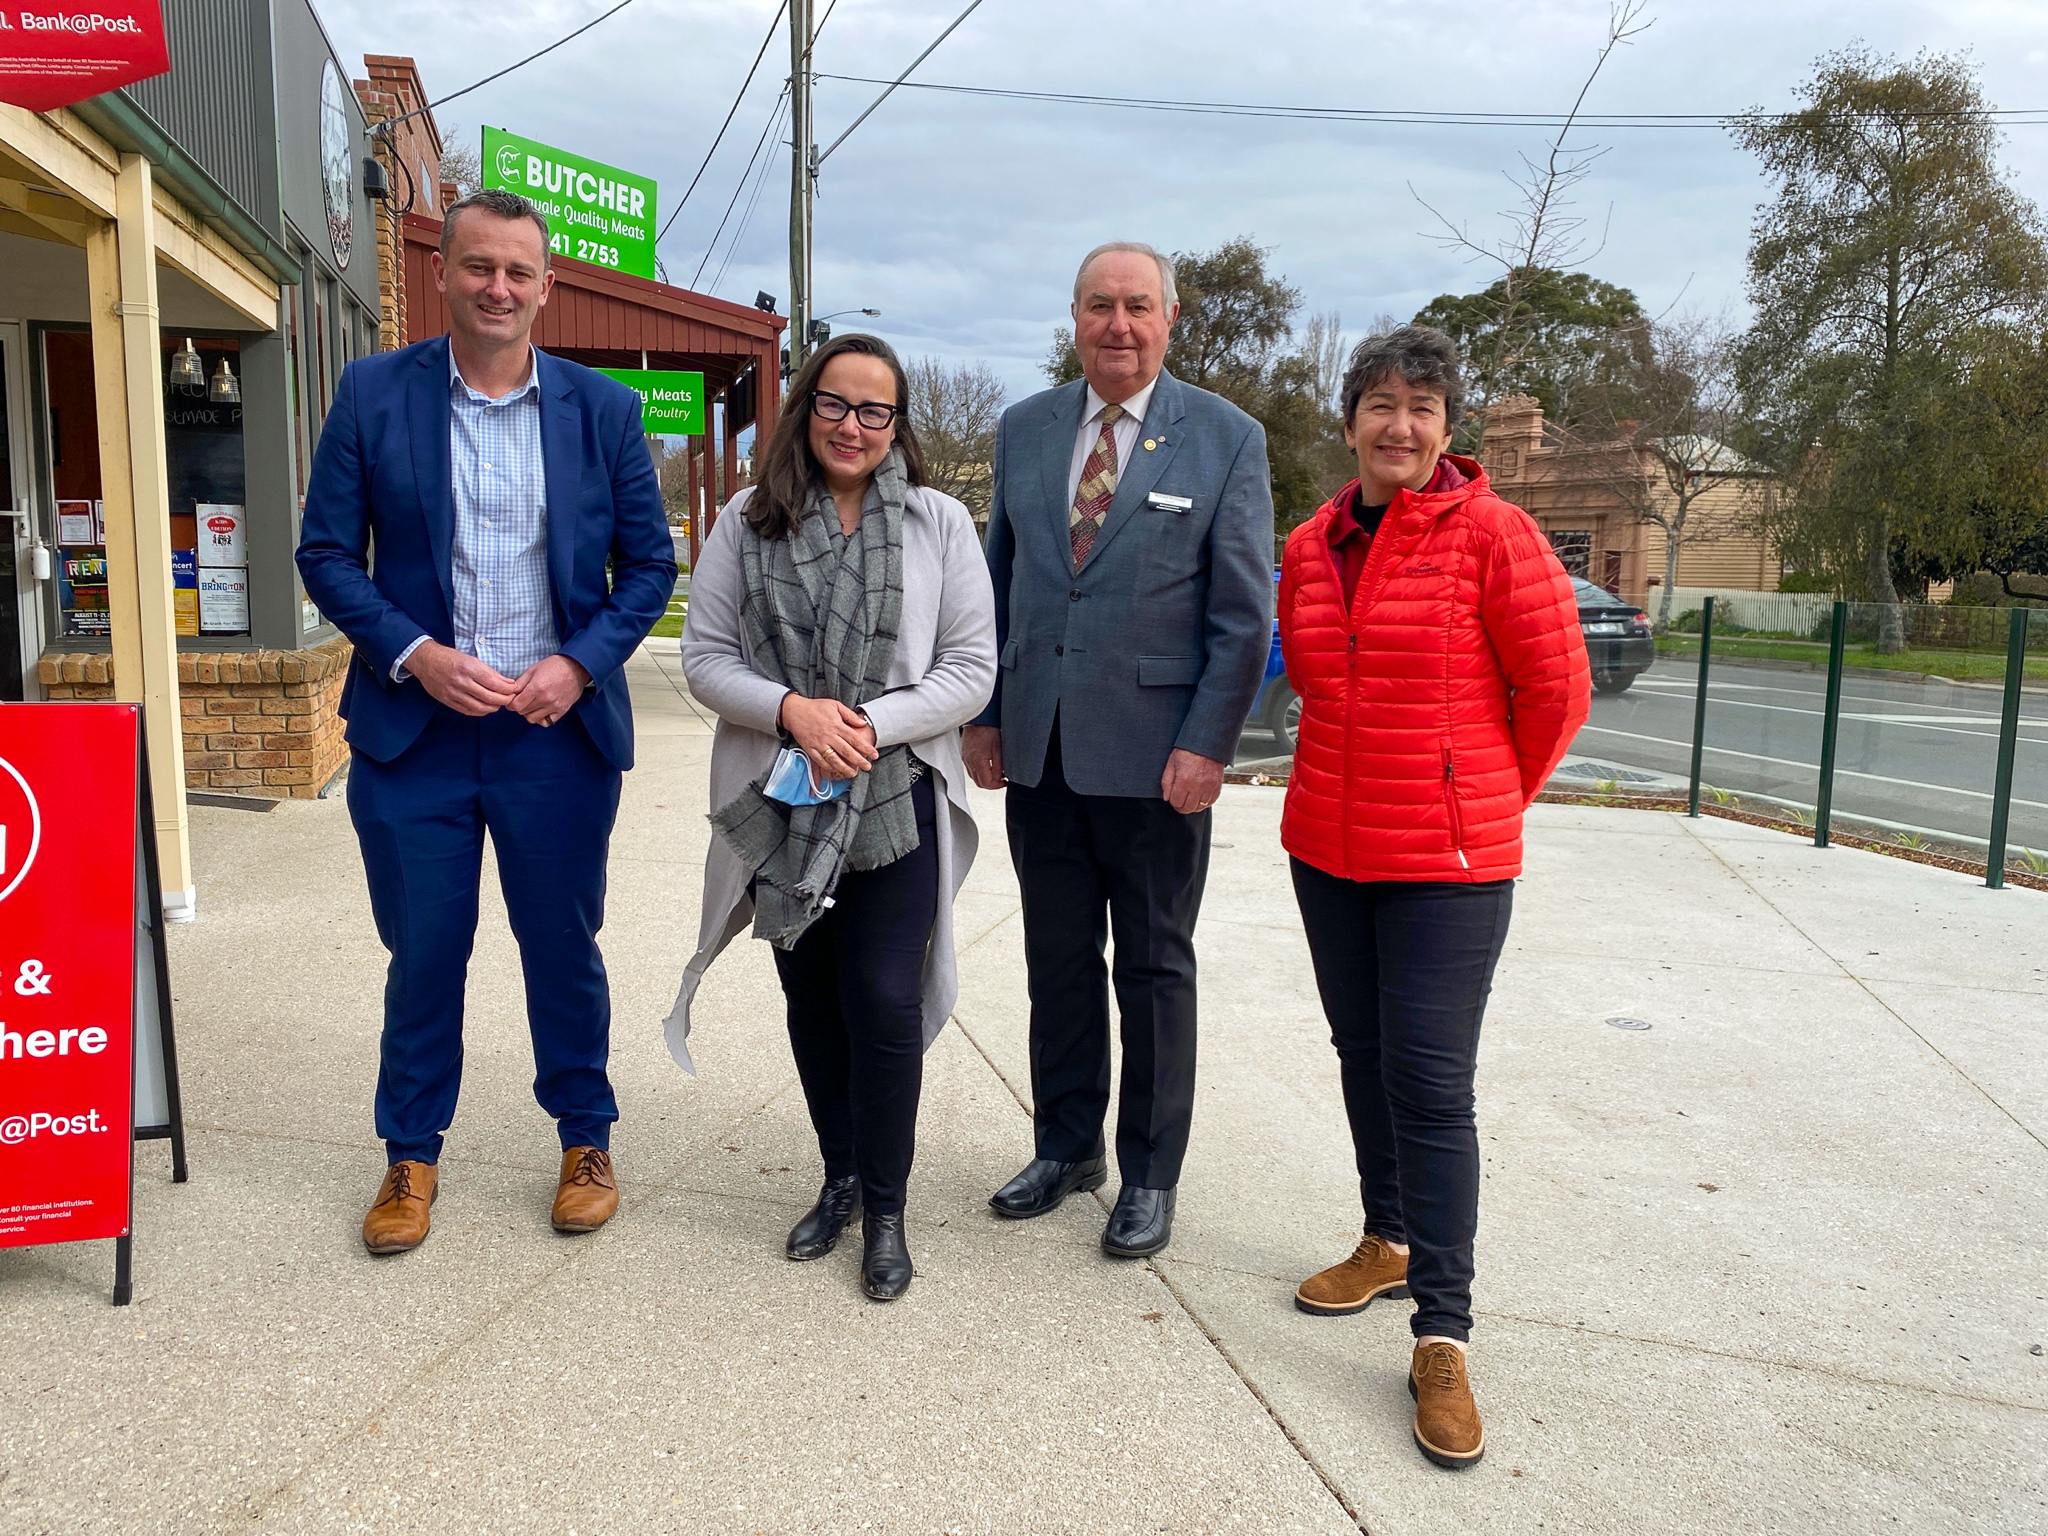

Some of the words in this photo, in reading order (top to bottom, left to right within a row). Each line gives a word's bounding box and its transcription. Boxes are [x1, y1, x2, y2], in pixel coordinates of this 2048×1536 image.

[20, 12, 142, 34] Bank@Post.
[526, 155, 645, 218] BUTCHER
[563, 204, 609, 234] Quality
[611, 218, 645, 241] Meats
[577, 239, 619, 267] 2753
[652, 388, 692, 402] Meats
[649, 406, 690, 421] Poultry
[14, 959, 52, 996] &
[0, 1021, 108, 1060] here
[11, 1205, 21, 1213] 80
[22, 1202, 52, 1211] financial
[53, 1199, 94, 1208] institutions.
[24, 1214, 41, 1223] your
[42, 1210, 72, 1220] financial
